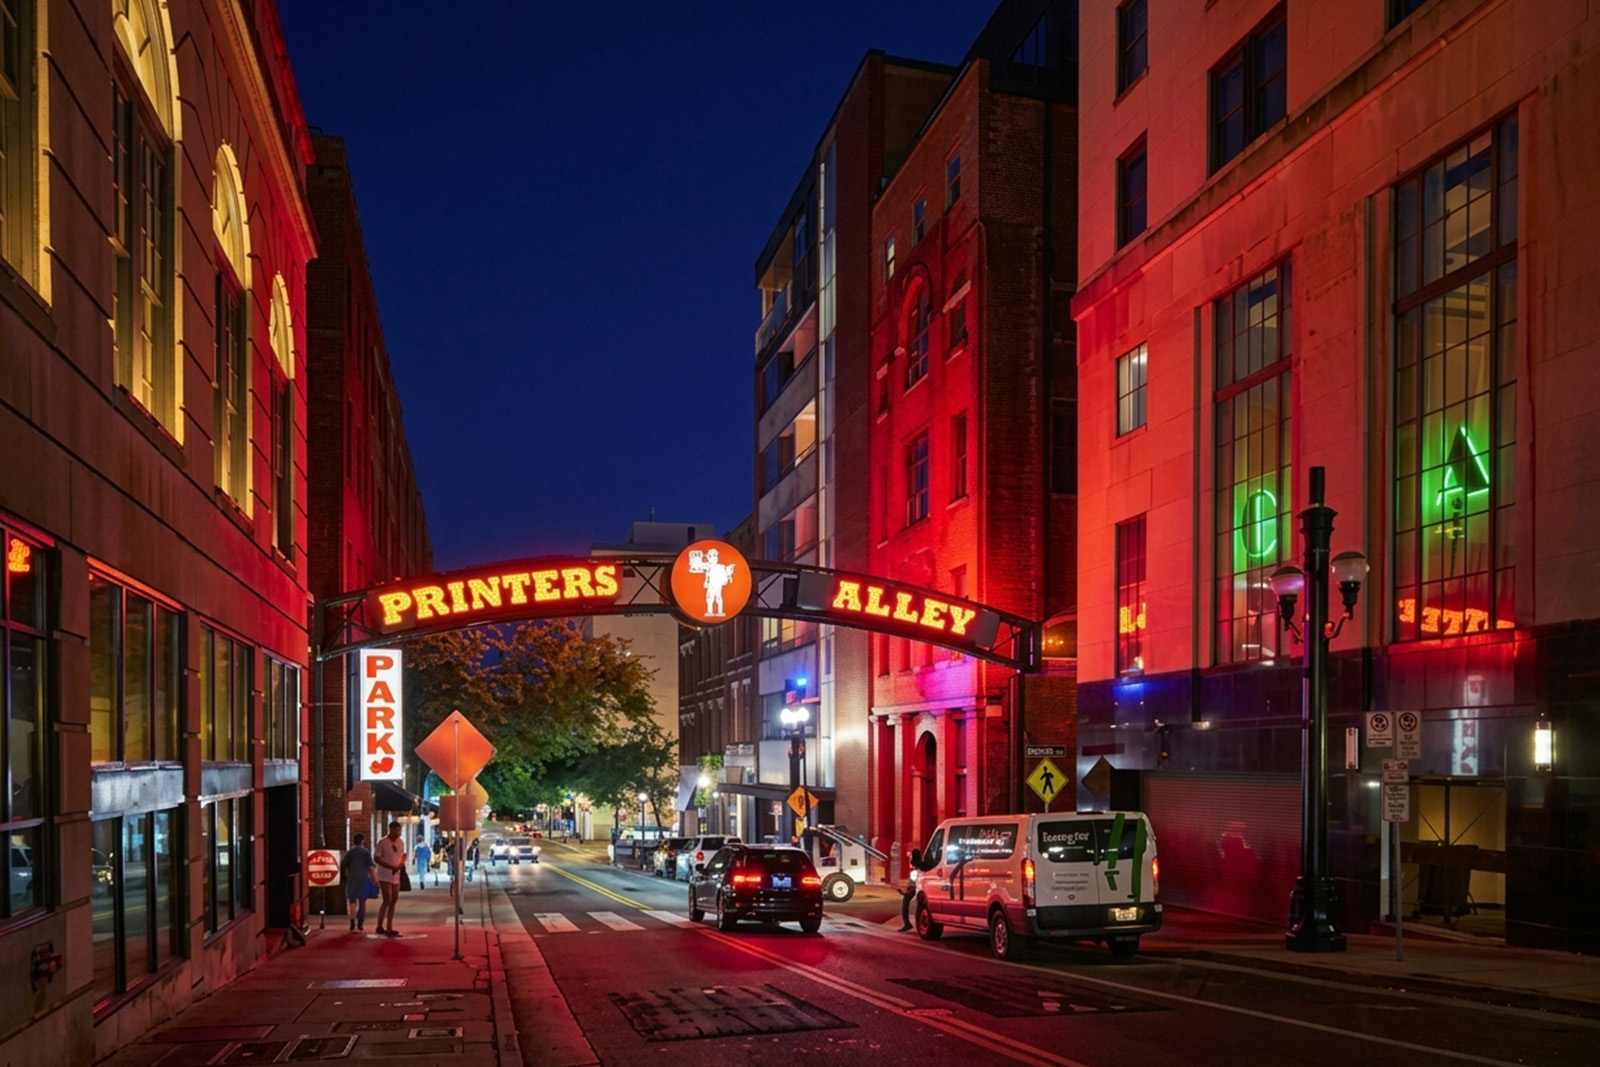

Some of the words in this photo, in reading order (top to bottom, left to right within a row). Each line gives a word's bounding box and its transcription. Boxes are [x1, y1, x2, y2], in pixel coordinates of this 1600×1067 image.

[378, 565, 619, 626] PRINTERS
[832, 580, 976, 636] ALLEY
[366, 655, 396, 755] PARK
